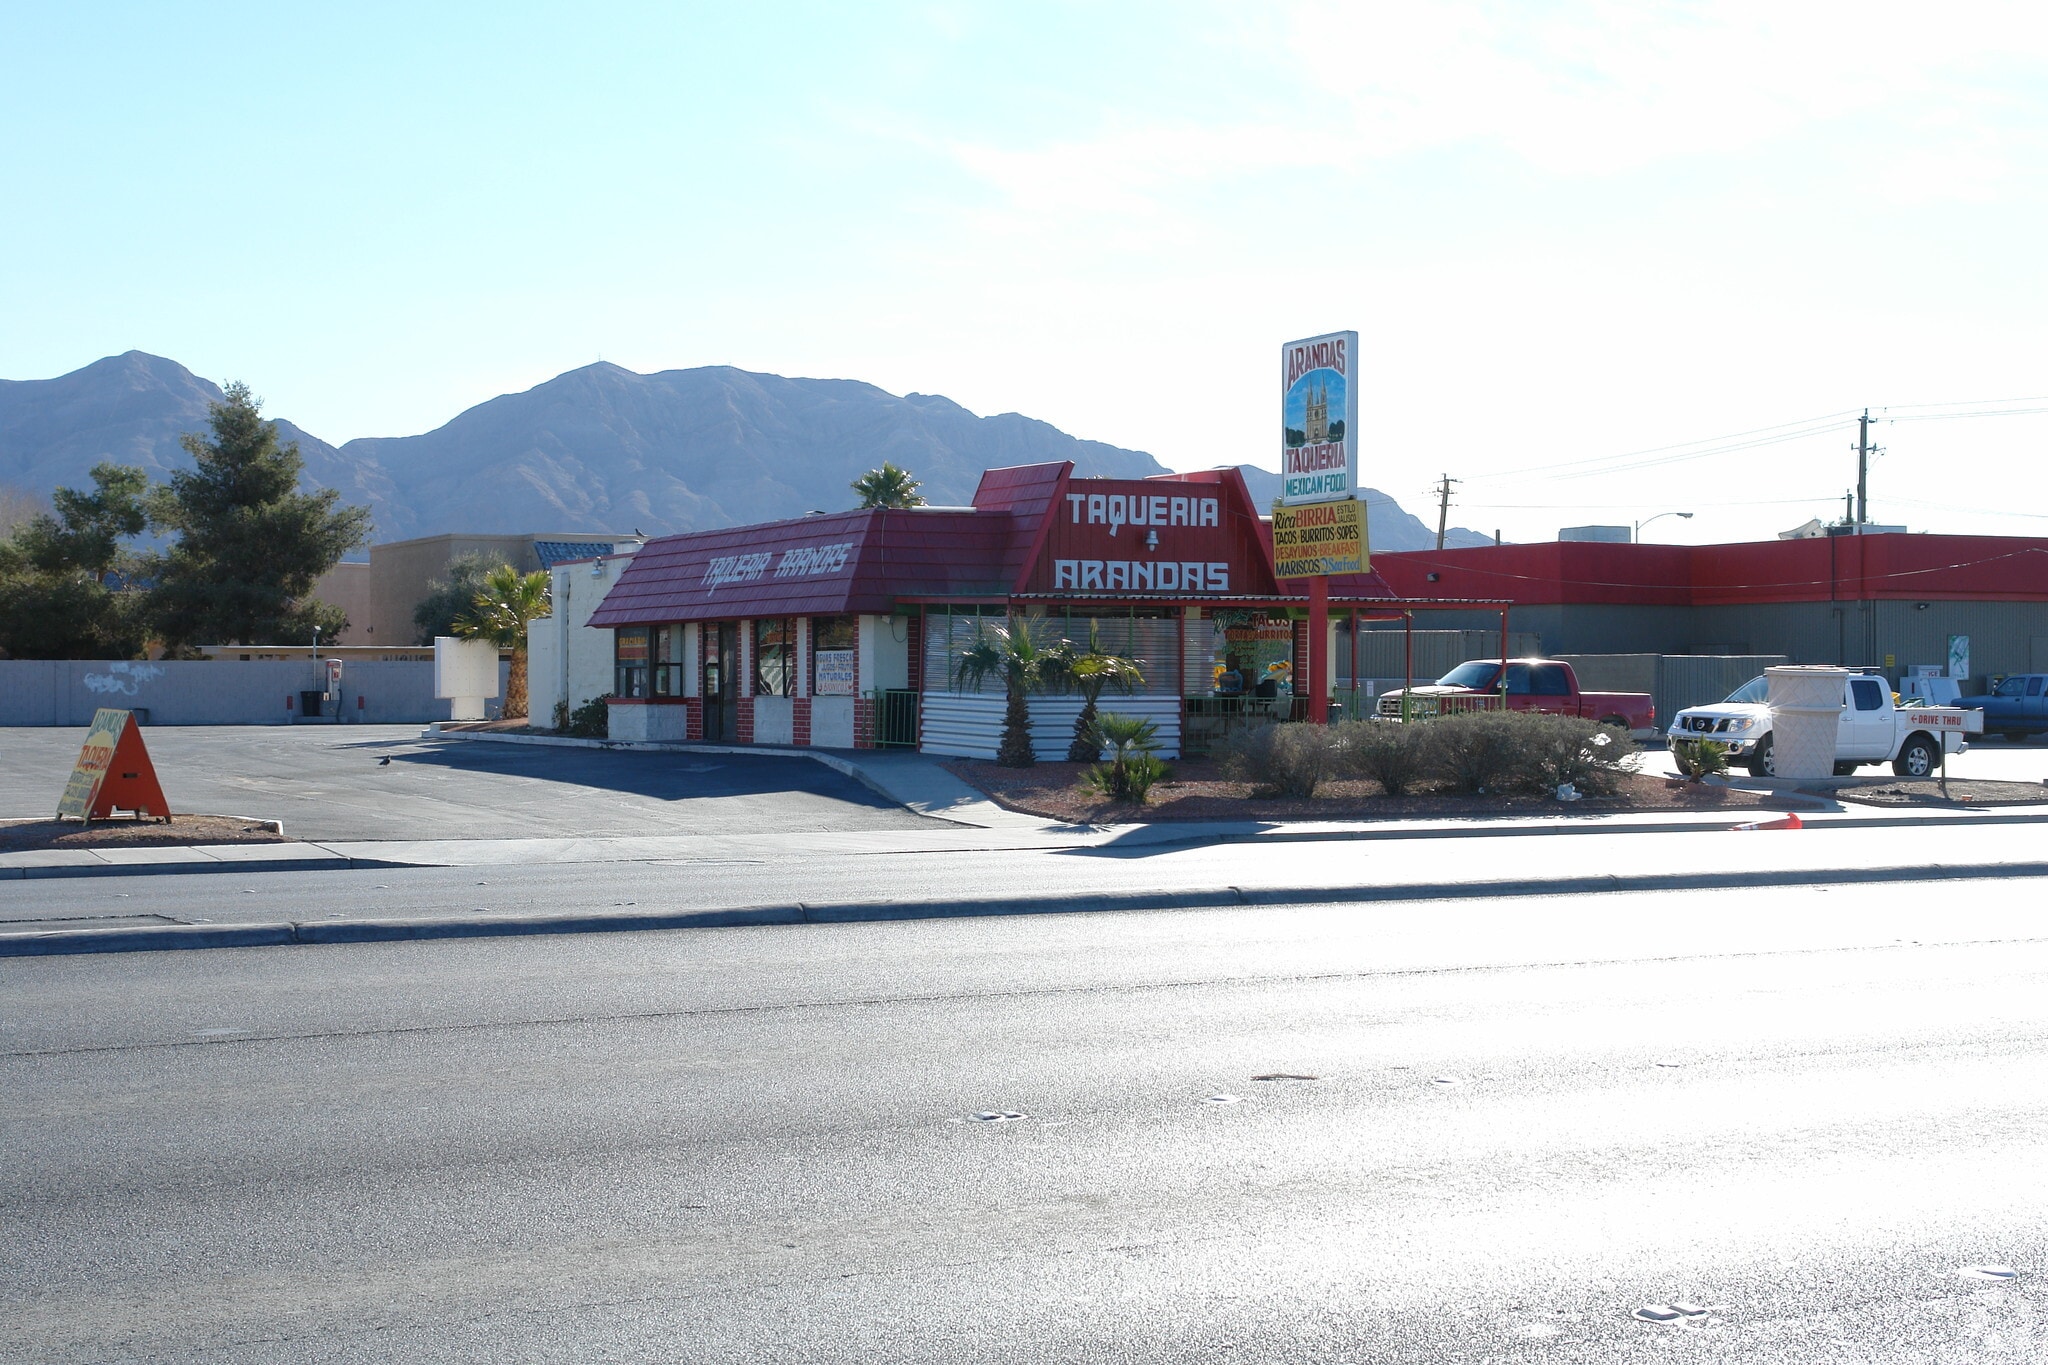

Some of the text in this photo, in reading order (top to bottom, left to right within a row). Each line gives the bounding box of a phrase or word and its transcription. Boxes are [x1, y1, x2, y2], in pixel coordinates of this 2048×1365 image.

[1287, 339, 1345, 392] ARANDAS
[1285, 442, 1346, 473] TAQUERIA
[1285, 473, 1346, 497] MEXICAN FOOD
[1066, 493, 1218, 537] TAQUERIA
[1274, 506, 1337, 529] Rica BIRRIA
[1337, 504, 1356, 514] ESTILO
[1337, 514, 1356, 523] JALISCO
[1275, 524, 1359, 545] TACOS BURRITOS SOPES
[1275, 541, 1359, 560] DESAYUNOS BREAKFAST
[701, 543, 854, 597] TAQUERIA ARANDAS
[1054, 559, 1229, 590] ARANDAS
[1276, 559, 1320, 576] MARISCOS
[1252, 614, 1290, 627] TACOS
[818, 672, 852, 681] NATURALES
[1918, 714, 1962, 725] DRIVE THRU
